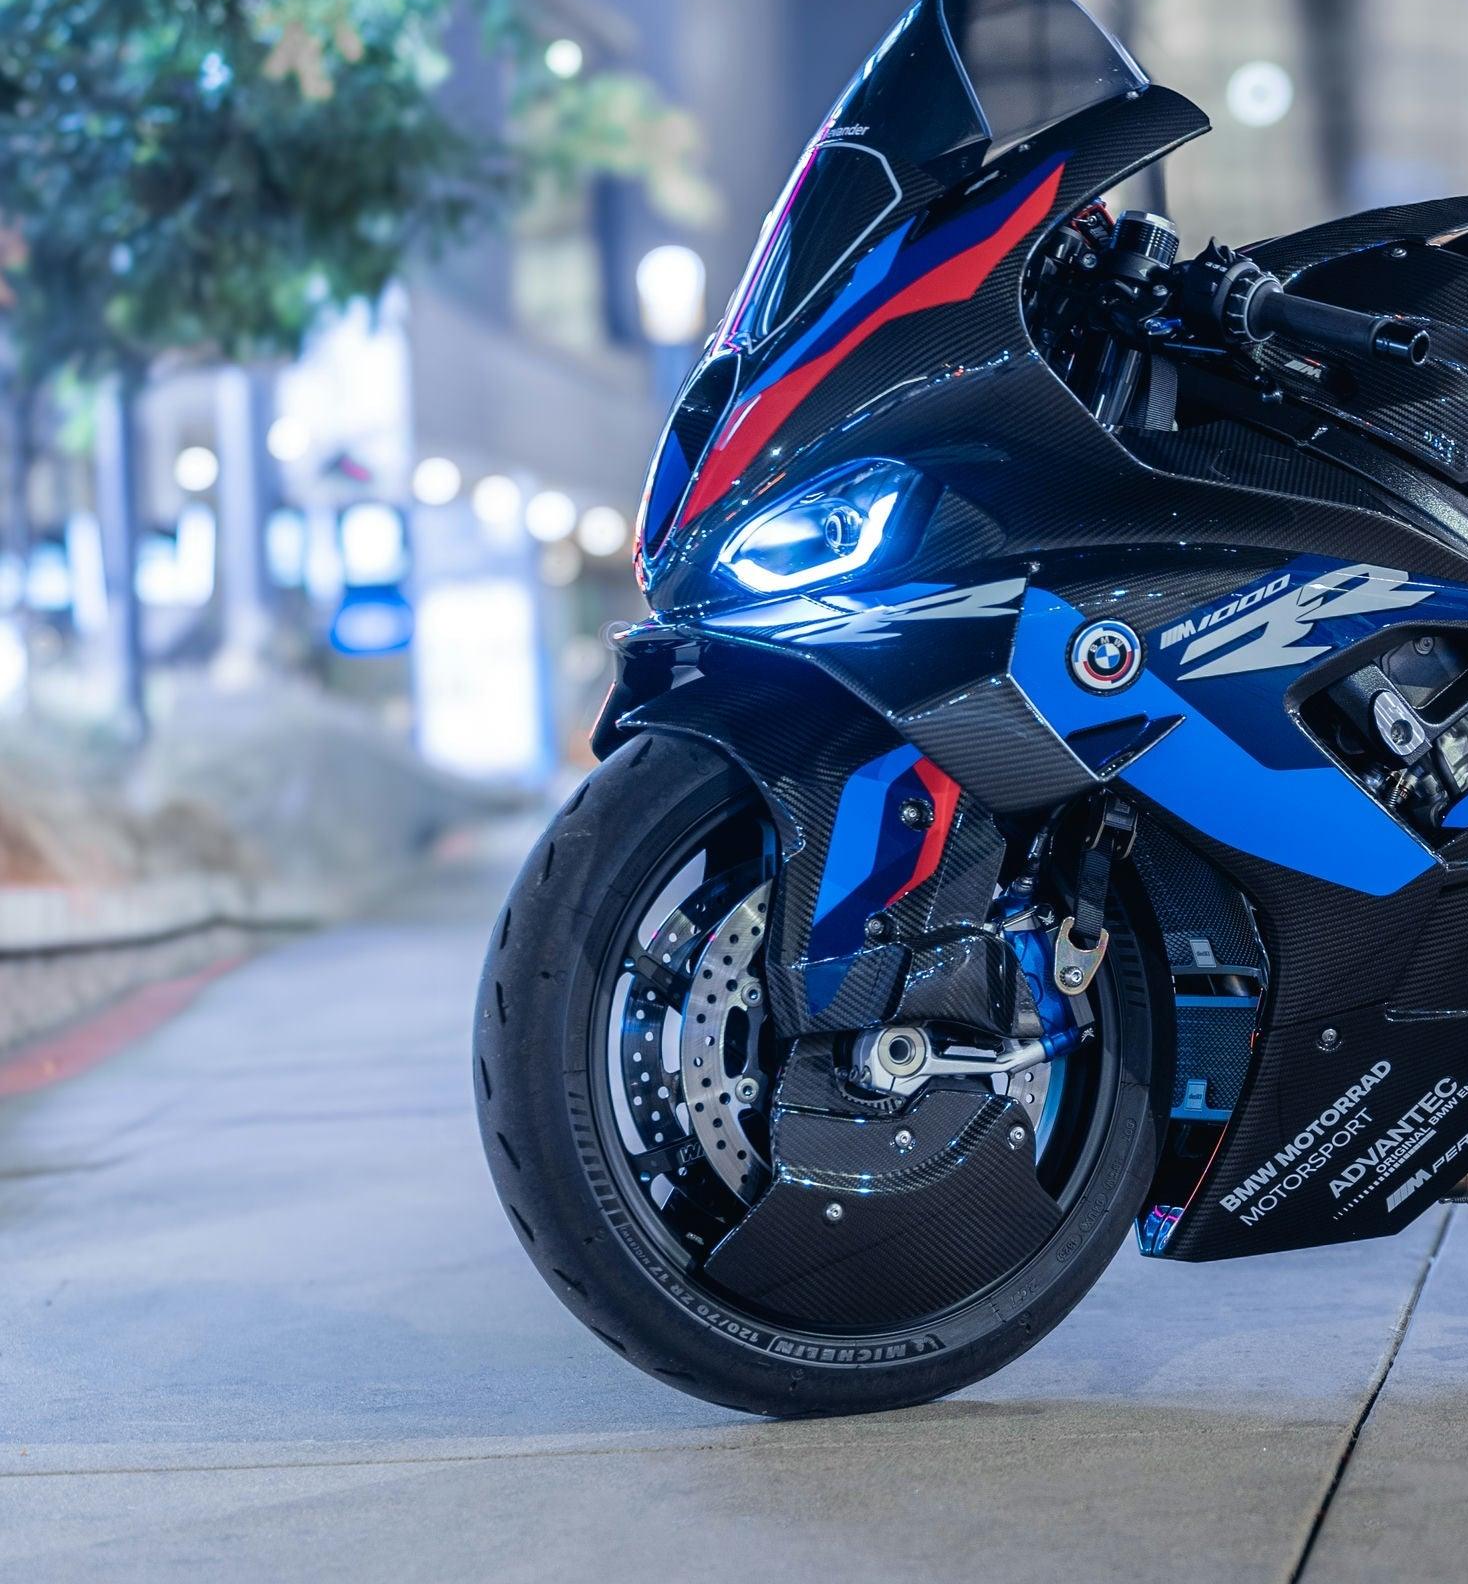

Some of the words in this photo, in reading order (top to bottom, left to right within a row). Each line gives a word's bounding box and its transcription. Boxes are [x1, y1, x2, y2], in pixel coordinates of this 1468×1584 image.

[1197, 573, 1291, 632] 1000
[1089, 635, 1126, 655] BMW
[1218, 1160, 1278, 1213] BMW
[1274, 1060, 1392, 1168] MOTORRAD
[1328, 1077, 1458, 1199] ADVANTEC
[1375, 1125, 1432, 1174] ORIGINAL
[1431, 1096, 1458, 1126] BMW
[1239, 1107, 1373, 1227] MOTORSPORT
[650, 1265, 670, 1283] 17
[669, 1284, 696, 1305] ZR
[697, 1304, 759, 1343] 120/70
[774, 1339, 907, 1363] MICHELIN
